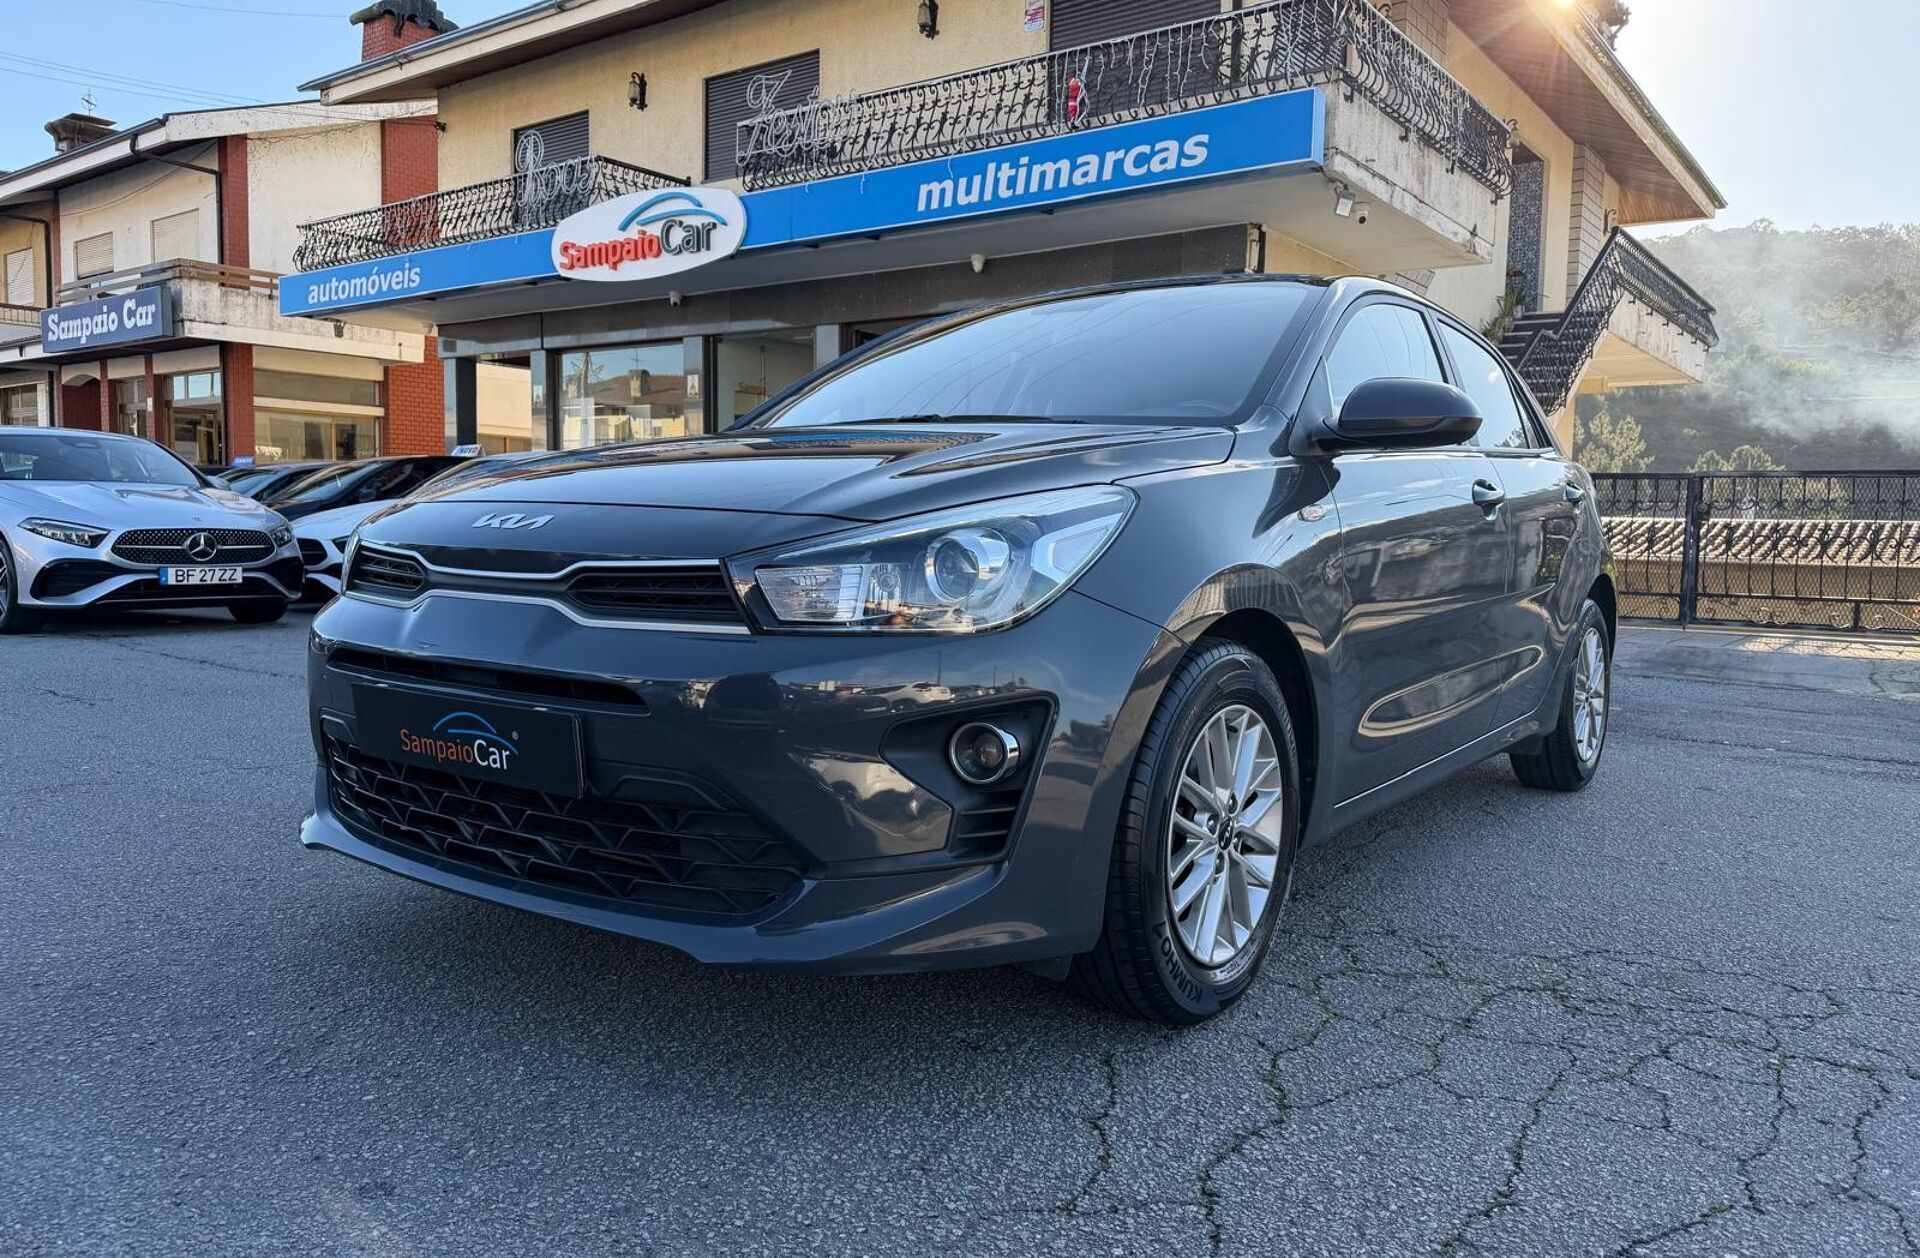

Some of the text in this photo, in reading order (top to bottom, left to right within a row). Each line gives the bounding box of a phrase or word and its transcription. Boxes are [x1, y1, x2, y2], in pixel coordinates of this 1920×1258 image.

[917, 133, 1210, 212] multimarcas
[307, 262, 421, 304] automóveis
[47, 299, 156, 344] Sampaio Car
[1161, 935, 1203, 1004] KUMHO
